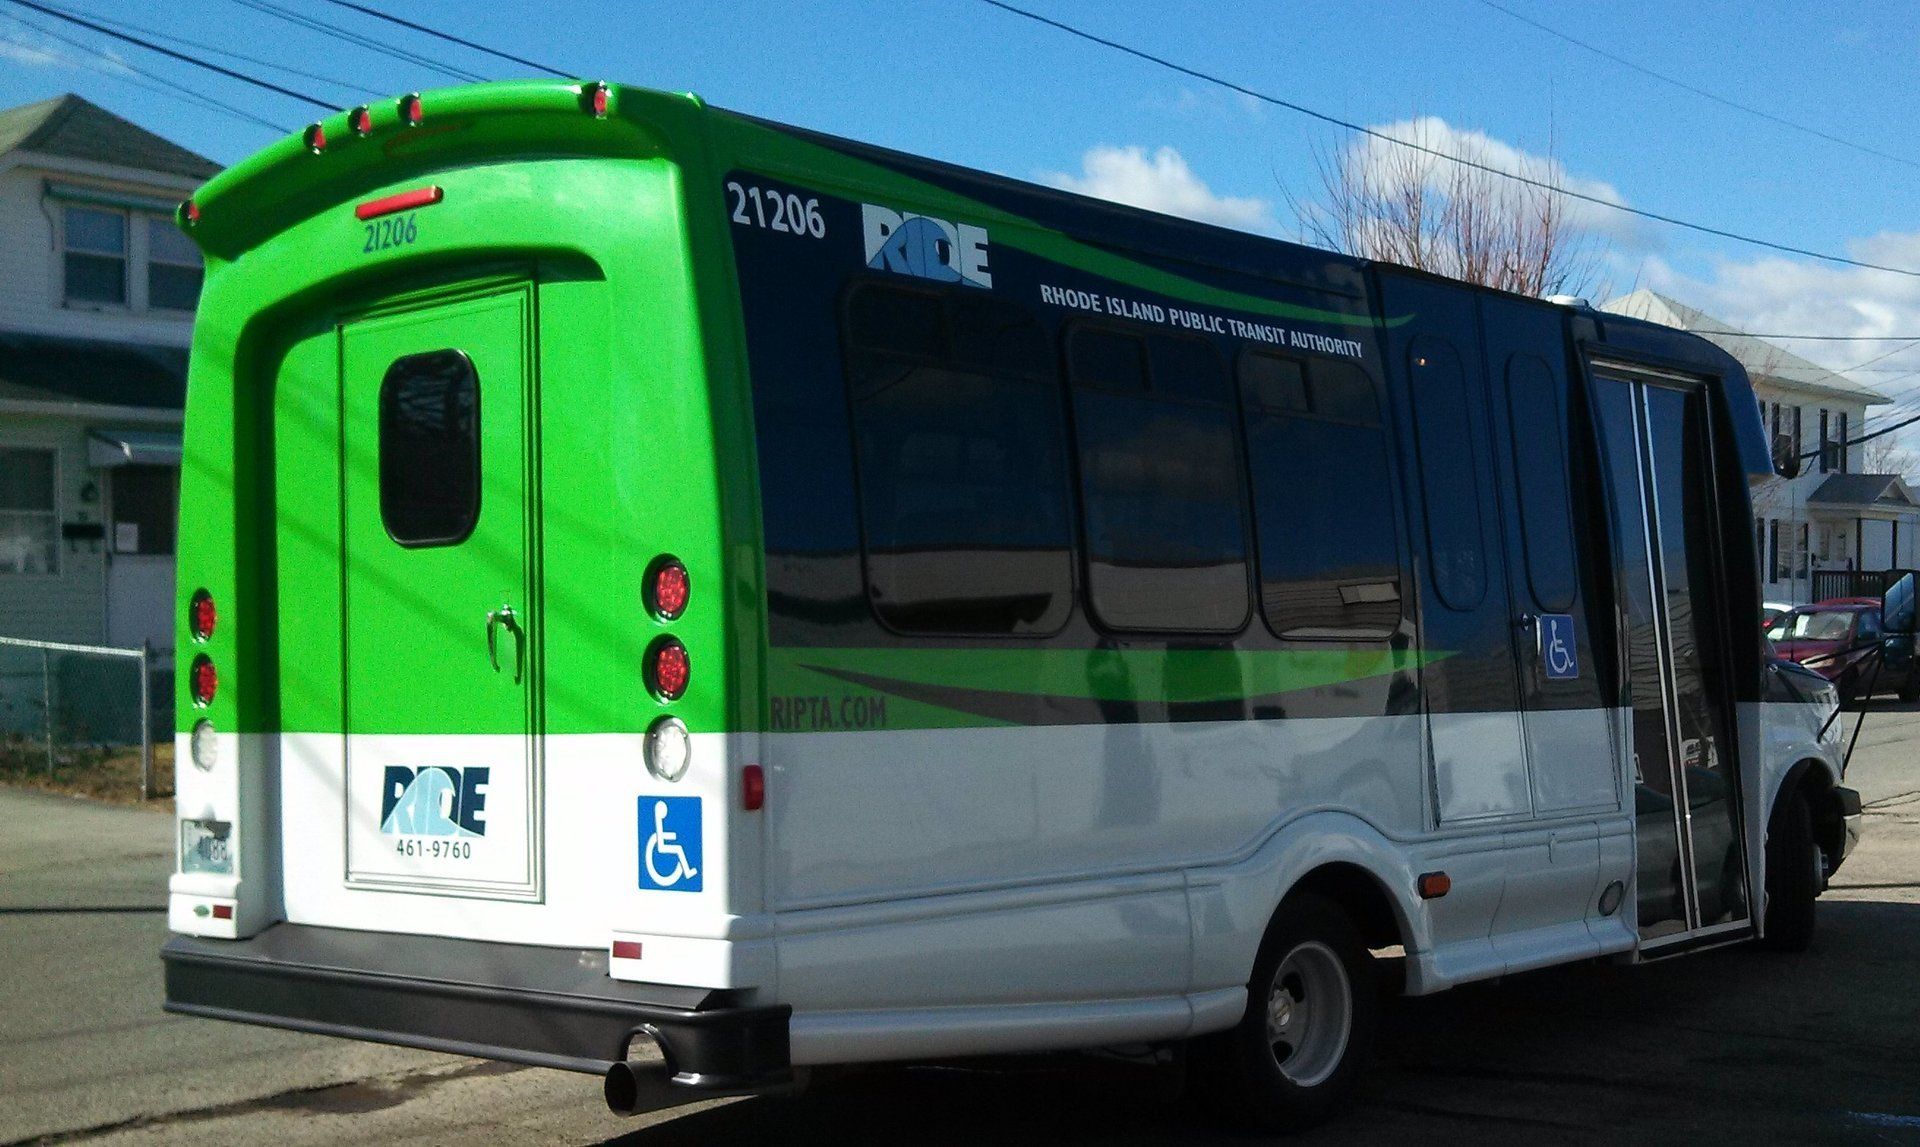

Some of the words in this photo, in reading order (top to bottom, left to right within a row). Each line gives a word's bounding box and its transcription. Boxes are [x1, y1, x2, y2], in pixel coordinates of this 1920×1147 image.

[363, 212, 417, 253] 21206
[727, 182, 826, 239] 21206
[861, 203, 993, 289] RIDE
[1040, 285, 1102, 313] RHODE
[1105, 296, 1165, 323] ISLAND
[1169, 308, 1225, 334] PUBLIC
[1227, 318, 1286, 345] TRANSIT
[1290, 331, 1362, 358] AUTHORITY
[770, 694, 887, 730] RIPTA.COM
[380, 765, 490, 837] RIDE
[396, 839, 471, 860] 461-9760
